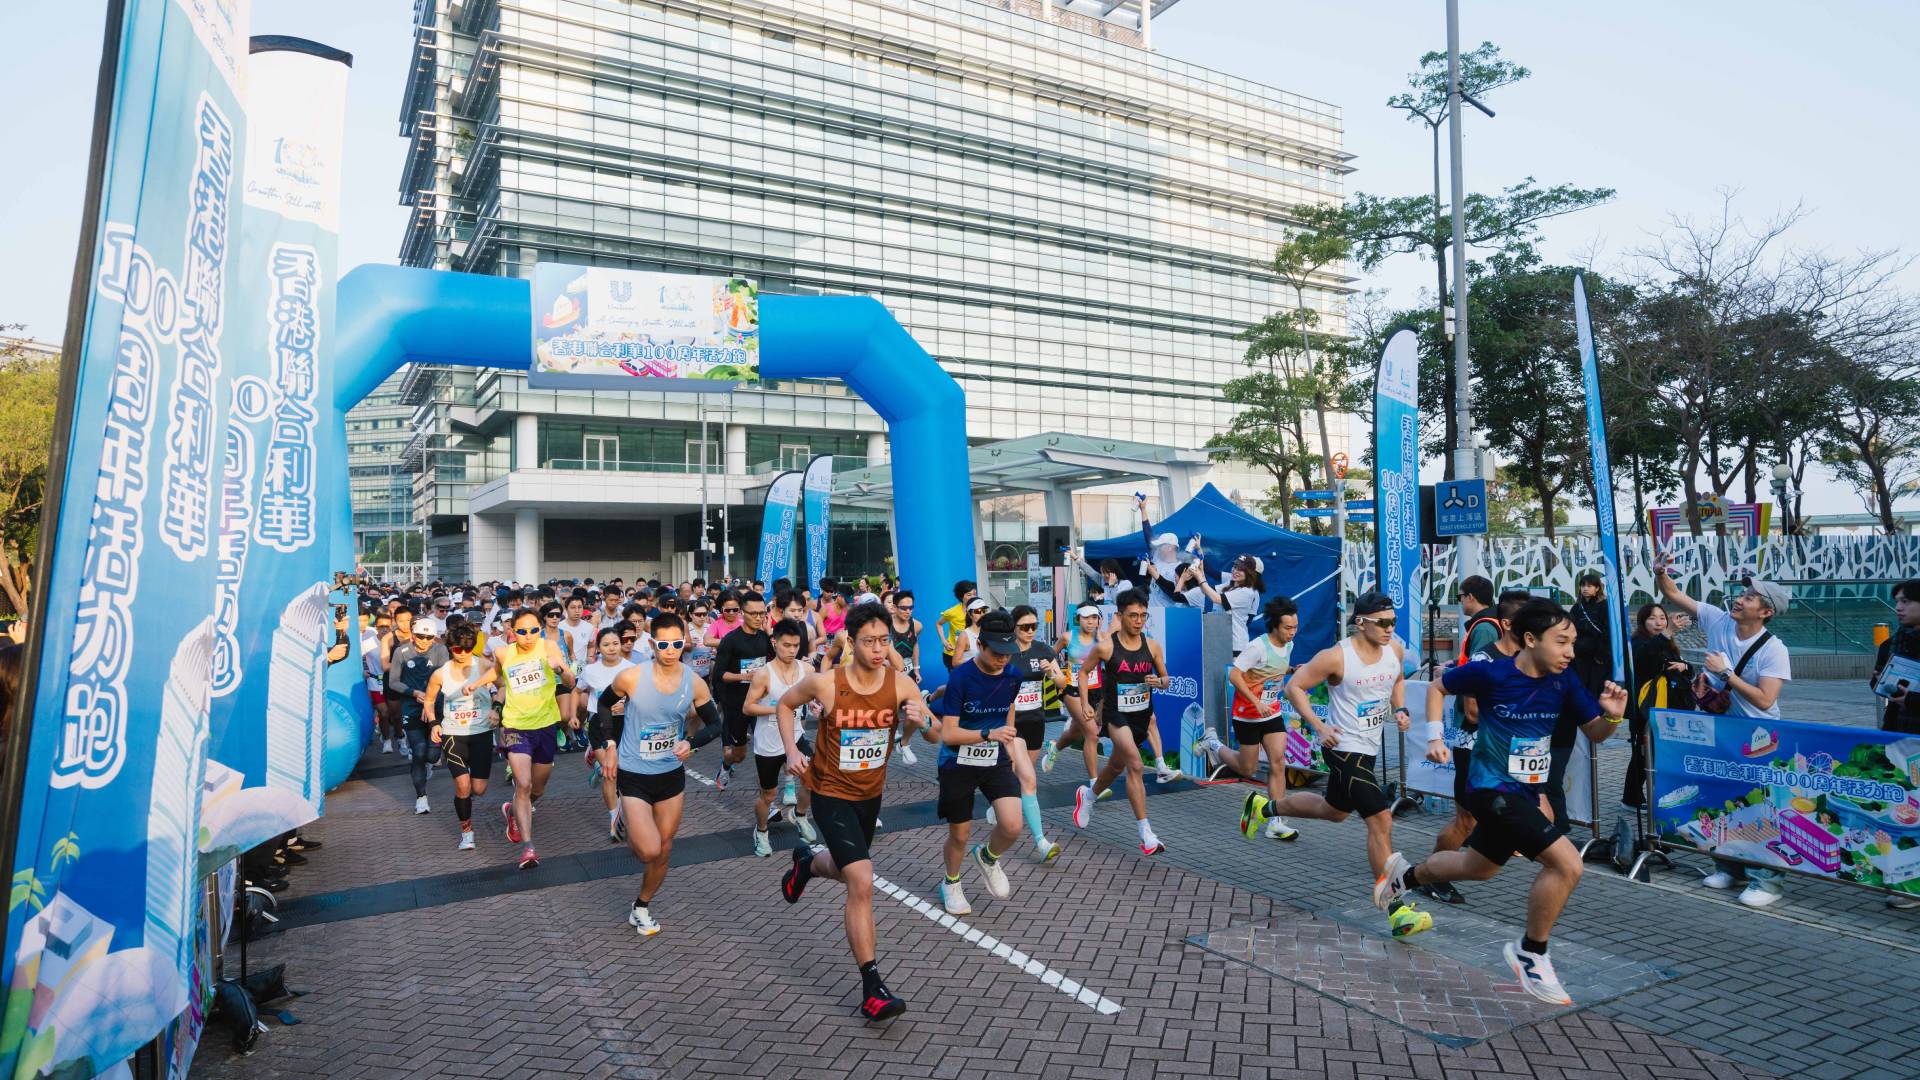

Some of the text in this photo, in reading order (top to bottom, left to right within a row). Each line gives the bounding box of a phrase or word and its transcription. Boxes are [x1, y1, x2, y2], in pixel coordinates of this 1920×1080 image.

[163, 93, 233, 560] 香港聯合利華
[552, 338, 747, 365] 香港聯合利華100周年活力跑
[256, 244, 320, 552] 香港聯合利華
[51, 222, 177, 789] 100周年活力跑
[1468, 495, 1479, 508] D
[514, 673, 541, 685] 1380
[1124, 695, 1146, 705] 1036
[454, 710, 478, 720] 2092
[835, 709, 894, 728] HKG
[1493, 704, 1537, 719] GALAXY
[648, 739, 675, 751] 1095
[850, 748, 882, 760] 1006
[966, 747, 995, 758] 1007
[1685, 756, 1904, 802] 香港聯合利華100周年活力跑
